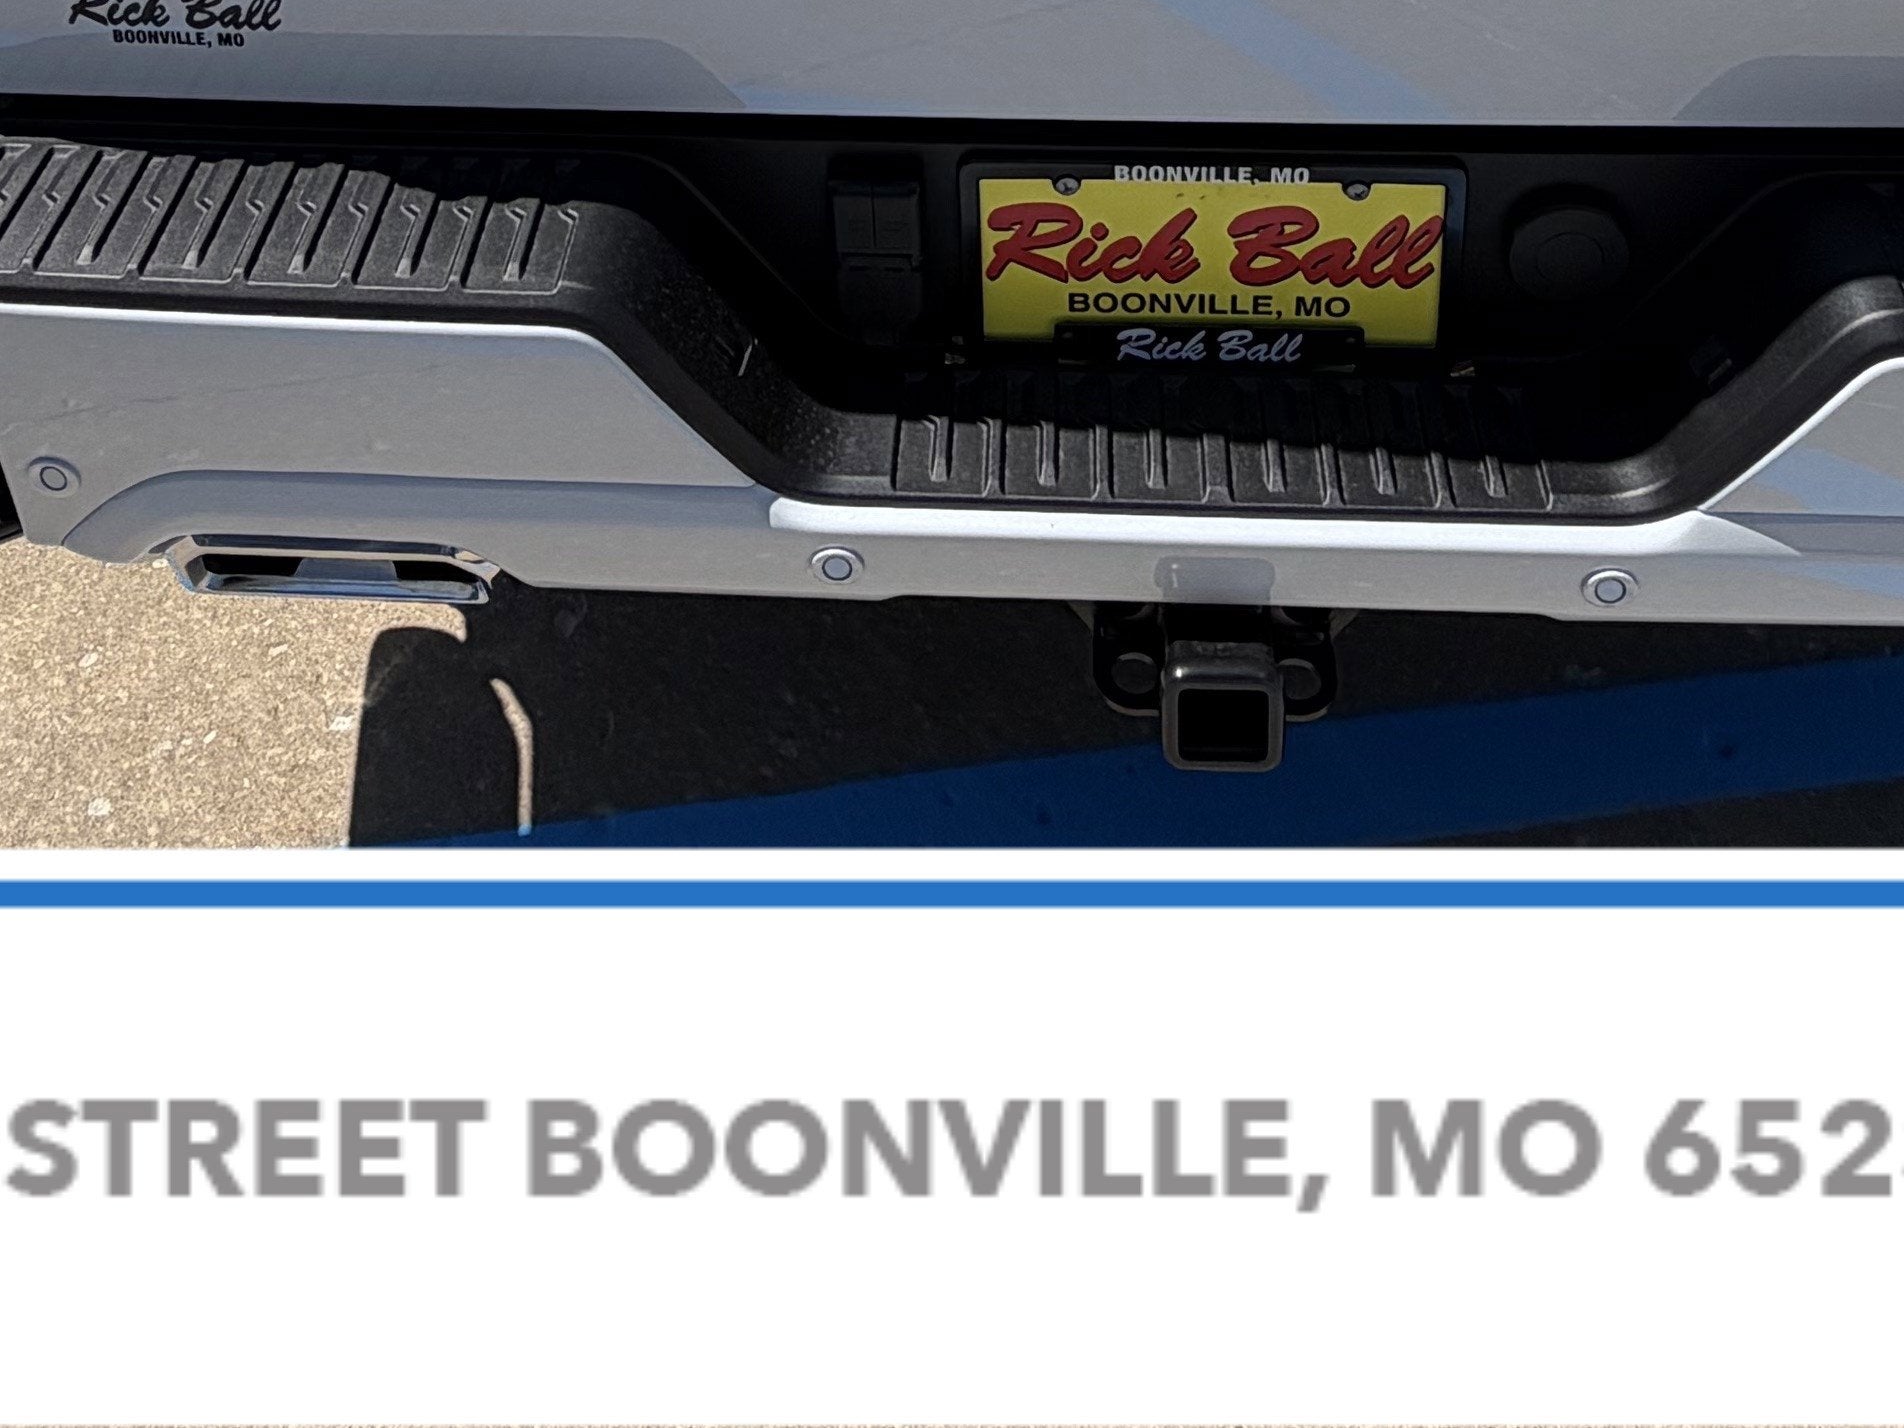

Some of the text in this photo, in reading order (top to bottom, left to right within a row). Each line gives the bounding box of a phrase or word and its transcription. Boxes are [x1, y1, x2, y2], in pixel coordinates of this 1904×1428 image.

[112, 29, 245, 48] BOONVILLE, MO
[1114, 165, 1311, 186] BOONVILLE, MO
[985, 201, 1444, 290] Rick Ball
[1067, 291, 1352, 320] BOONVILLE, MO
[1116, 328, 1302, 363] Rick Ball
